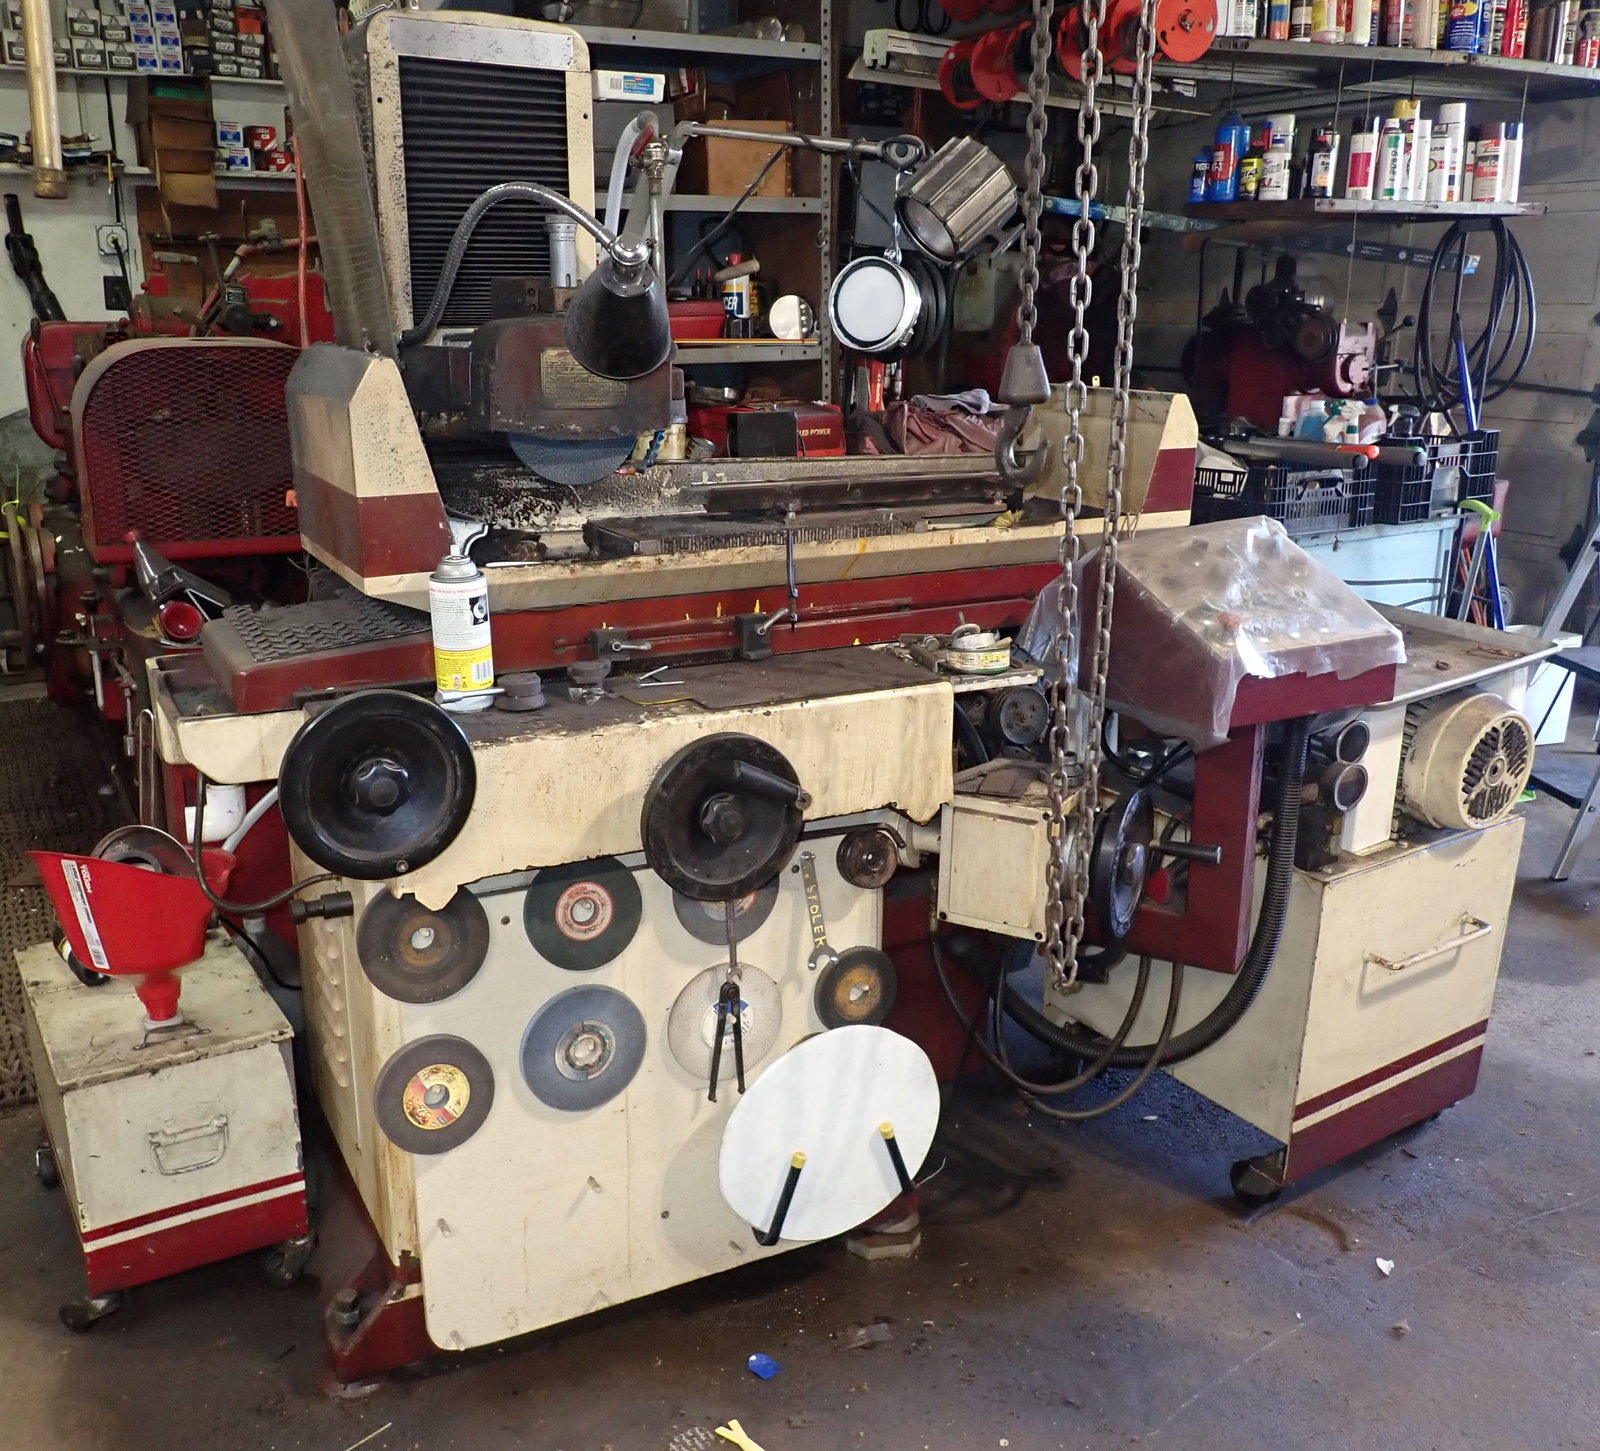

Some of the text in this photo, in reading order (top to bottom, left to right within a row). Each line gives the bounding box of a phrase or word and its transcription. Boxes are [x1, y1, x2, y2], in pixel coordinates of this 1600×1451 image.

[810, 427, 831, 436] POWER
[80, 866, 93, 893] TOUGH
[76, 880, 87, 906] EQUIPMENT
[84, 907, 92, 924] FUNNEL
